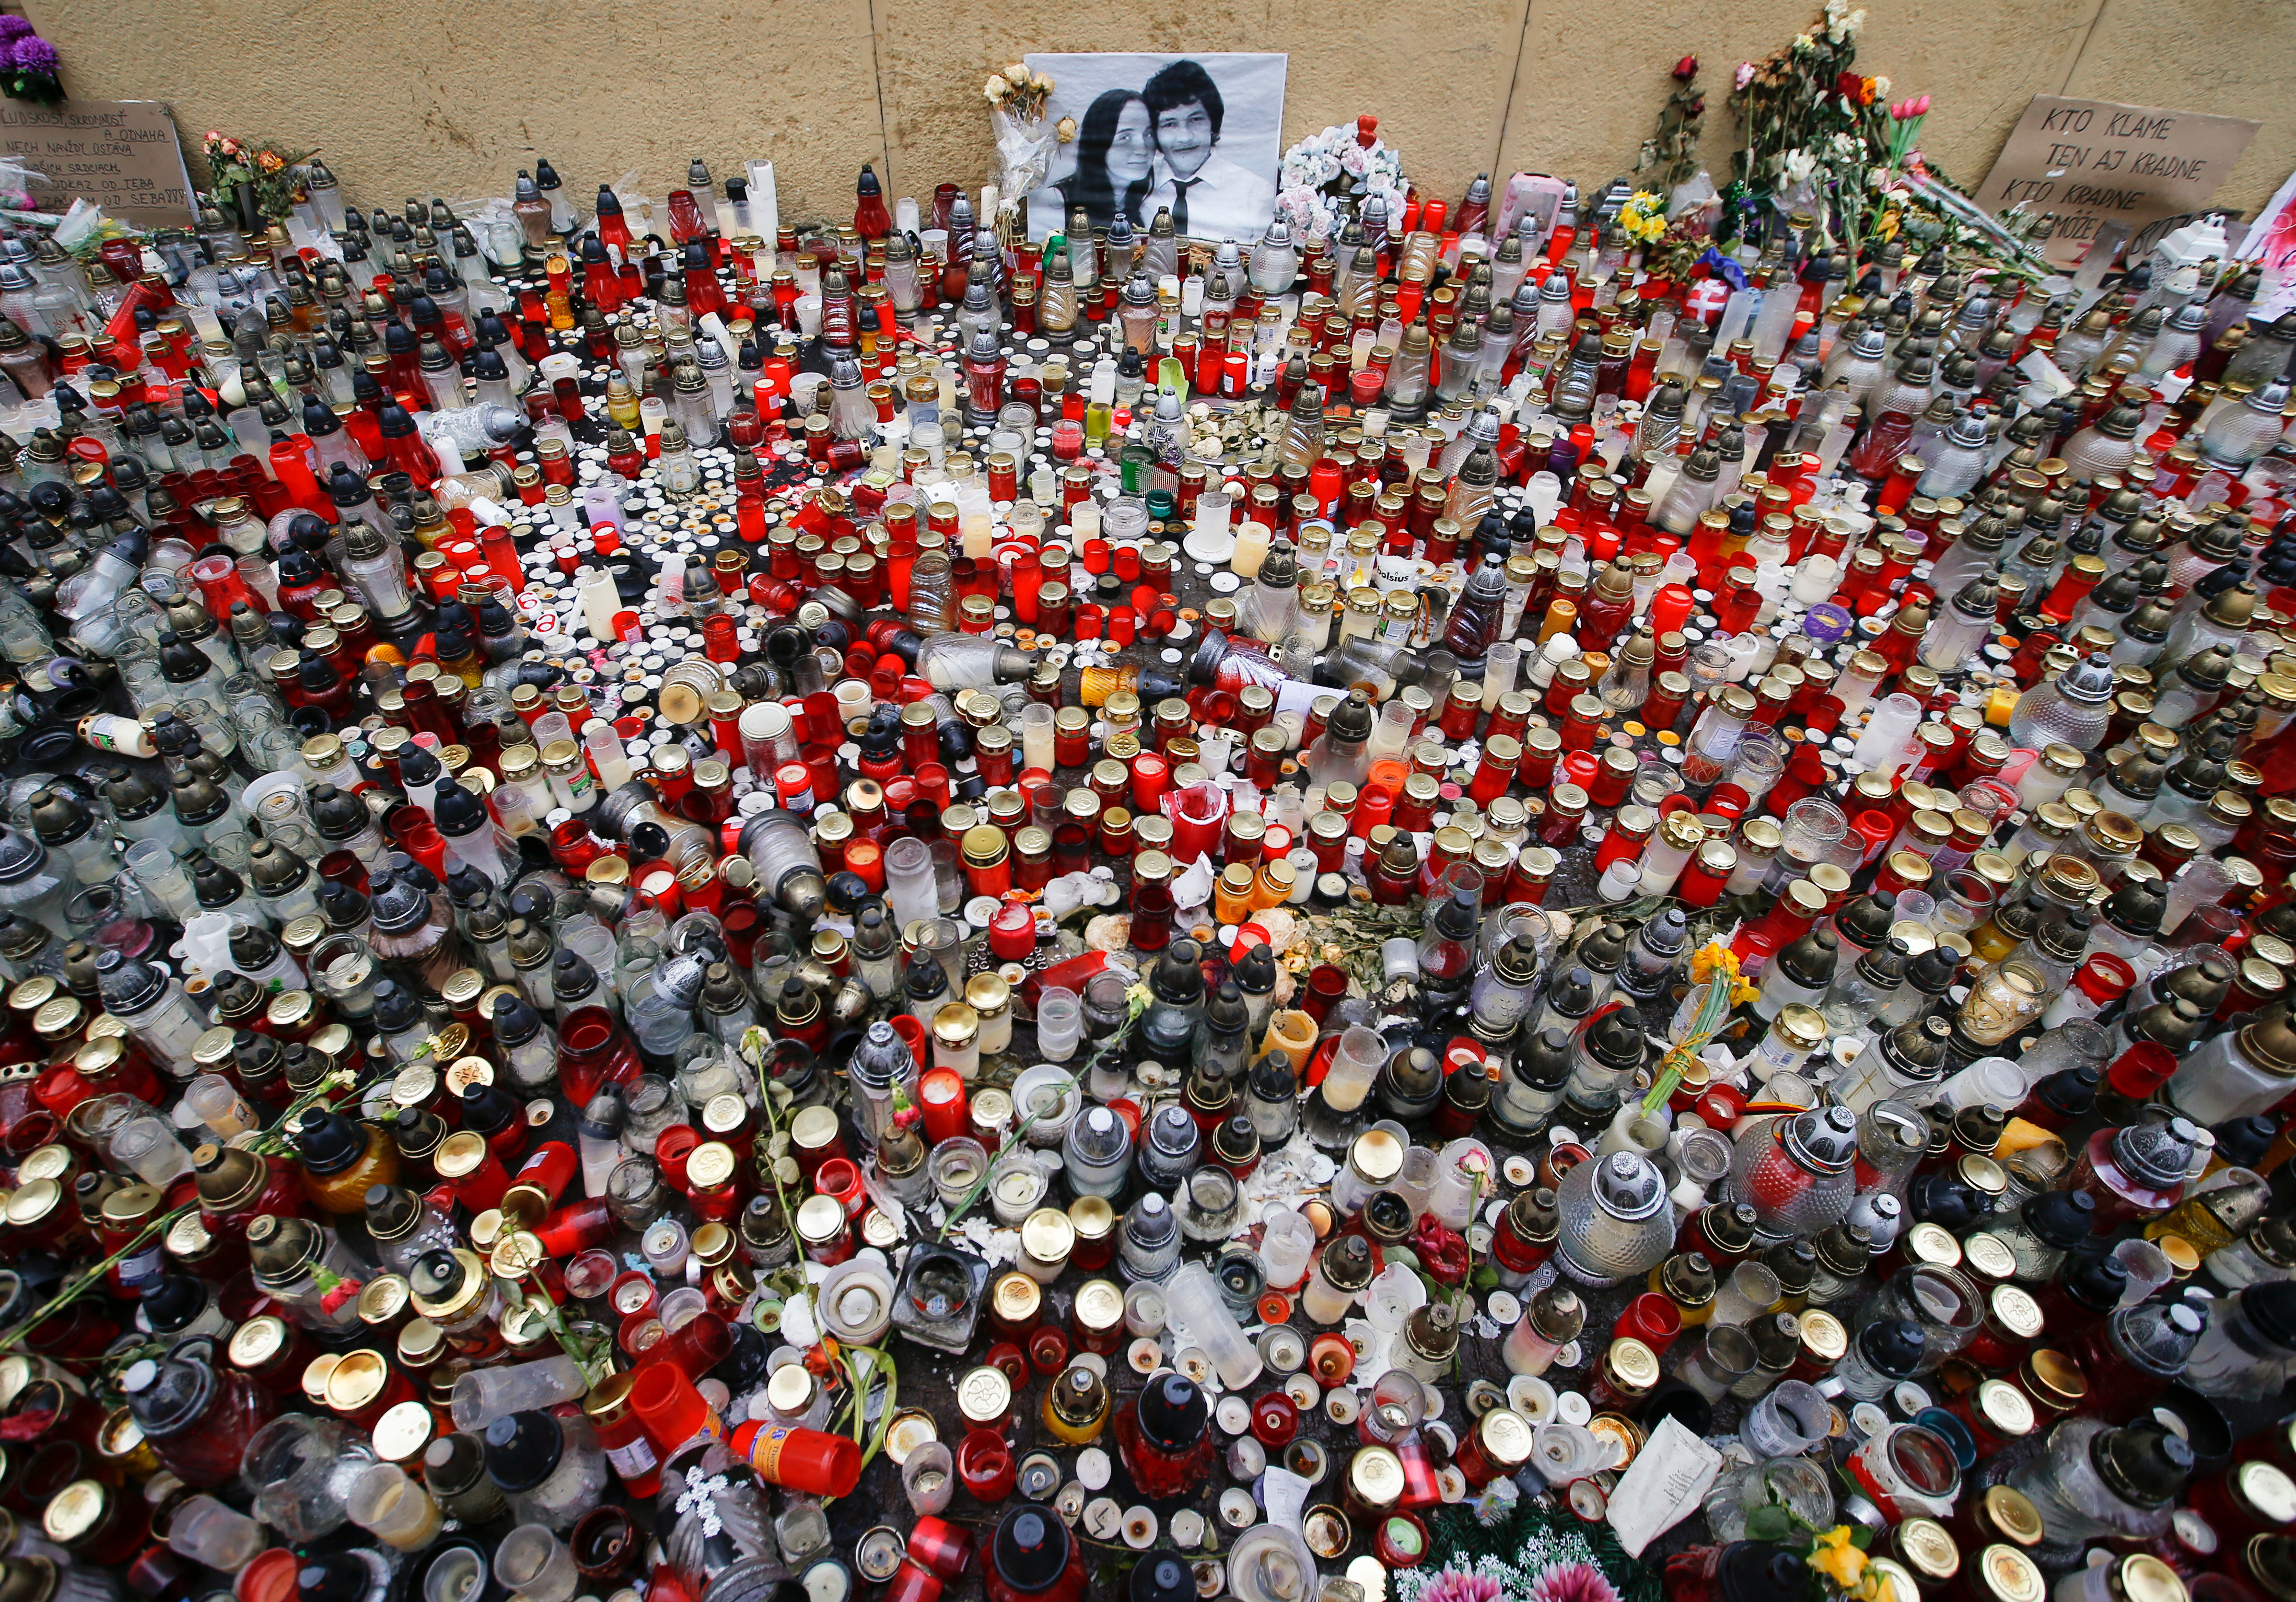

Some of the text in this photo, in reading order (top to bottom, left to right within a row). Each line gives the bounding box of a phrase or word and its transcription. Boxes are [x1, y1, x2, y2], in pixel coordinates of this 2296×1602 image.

[2040, 108, 2177, 140] KTO KLAME
[104, 129, 165, 141] A ODVAHA
[6, 140, 39, 153] NECH
[47, 139, 87, 154] NAVŽDY
[2045, 143, 2208, 183] TEN AJ KRADNE,
[52, 179, 94, 190] ODKAZ
[101, 180, 116, 189] OD
[124, 178, 155, 189] TEBA
[104, 195, 121, 206] OD
[1999, 178, 2147, 210] KTO KRADNE
[1378, 566, 1409, 582] bolsius
